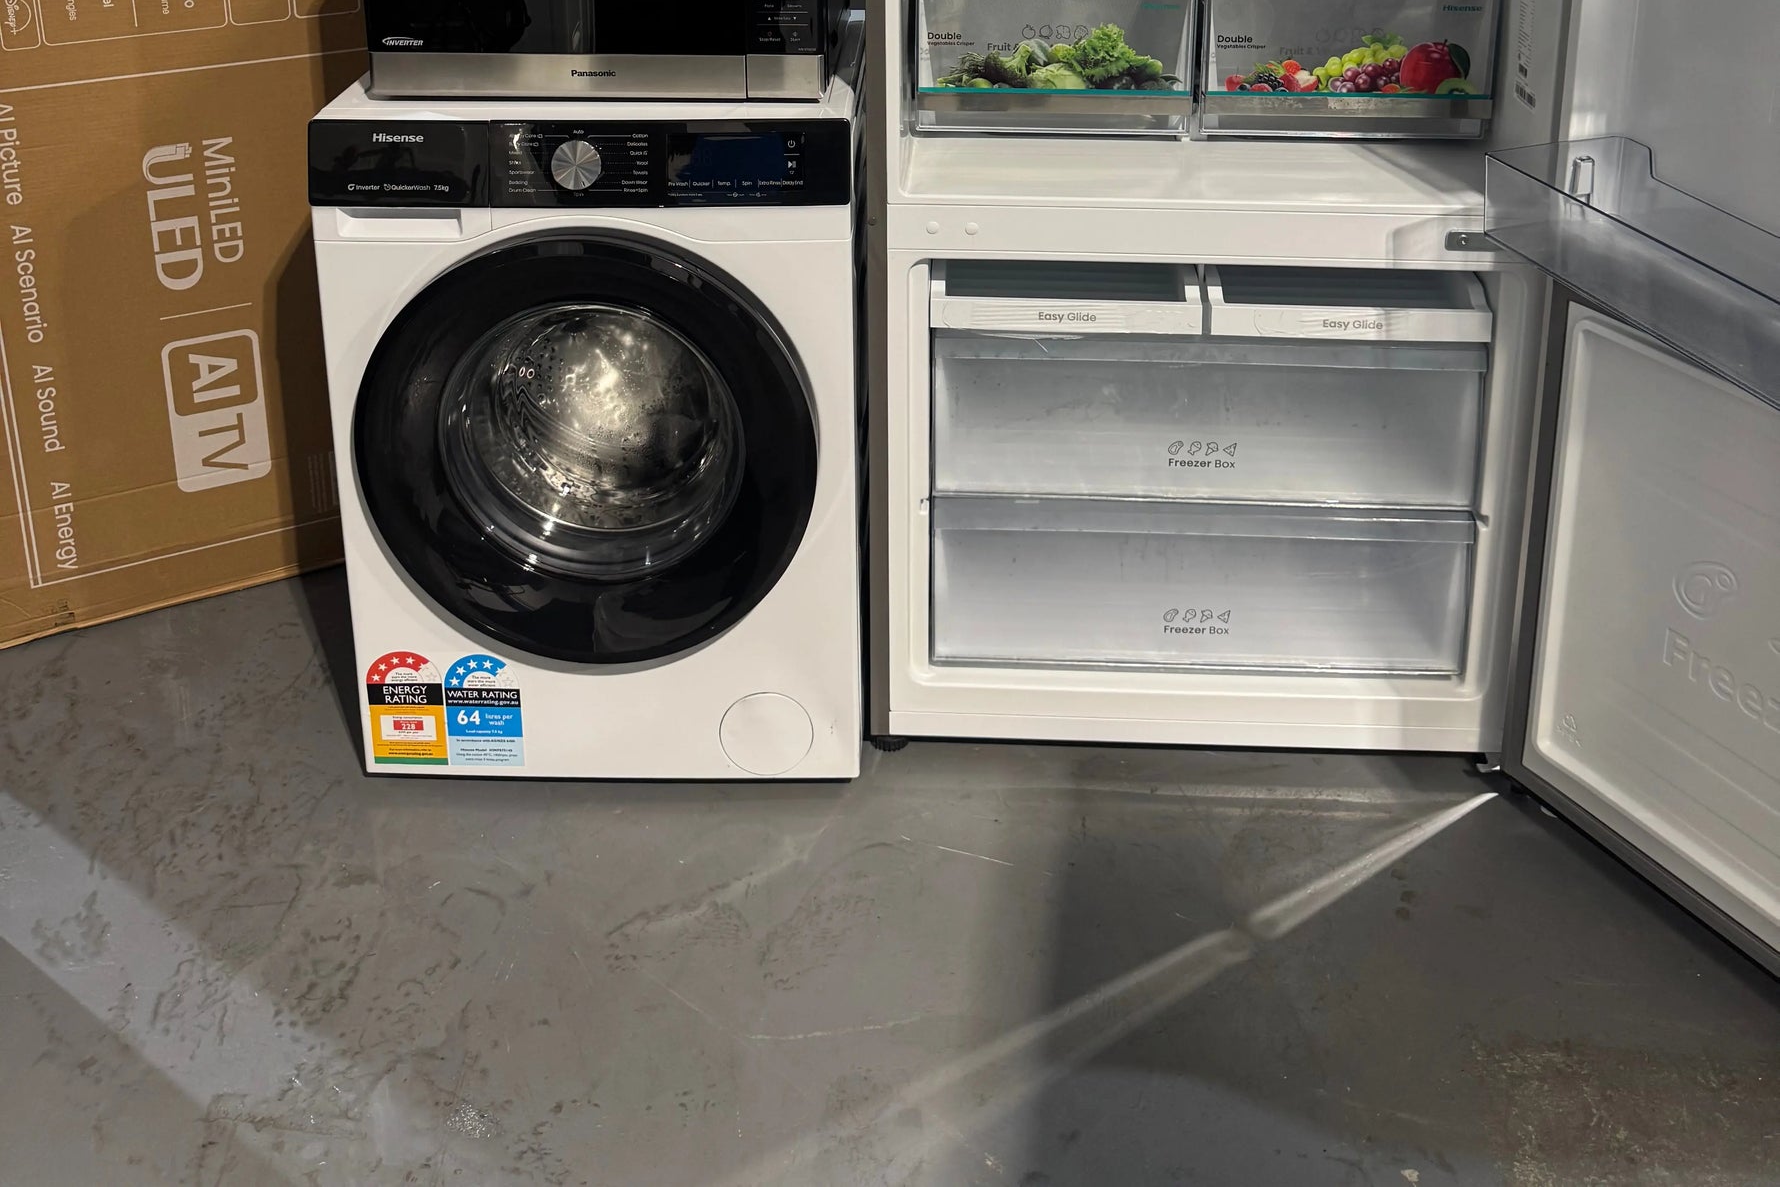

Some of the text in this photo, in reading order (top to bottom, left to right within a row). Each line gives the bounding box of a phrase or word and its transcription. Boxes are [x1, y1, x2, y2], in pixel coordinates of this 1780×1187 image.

[1442, 4, 1483, 12] Hisense
[927, 32, 962, 40] Double
[1217, 35, 1253, 43] Double
[987, 42, 1011, 51] Fruit
[571, 69, 616, 77] Panasonic
[372, 133, 424, 143] Hisense
[0, 128, 23, 206] Picture
[202, 136, 244, 264] MiniLED
[142, 142, 204, 291] ULED
[10, 224, 48, 344] AI Scenario
[1038, 311, 1096, 323] Easy Glide
[1322, 319, 1383, 330] Easy Glide
[31, 364, 65, 453] AI Sound
[1168, 458, 1235, 468] Freezer Box
[50, 481, 73, 499] AI
[53, 501, 79, 570] Energy
[1163, 625, 1229, 635] Freezer Box
[382, 685, 427, 694] ENERGY
[447, 690, 518, 699] WATER RATING
[385, 695, 428, 704] RATING
[457, 709, 481, 725] 64
